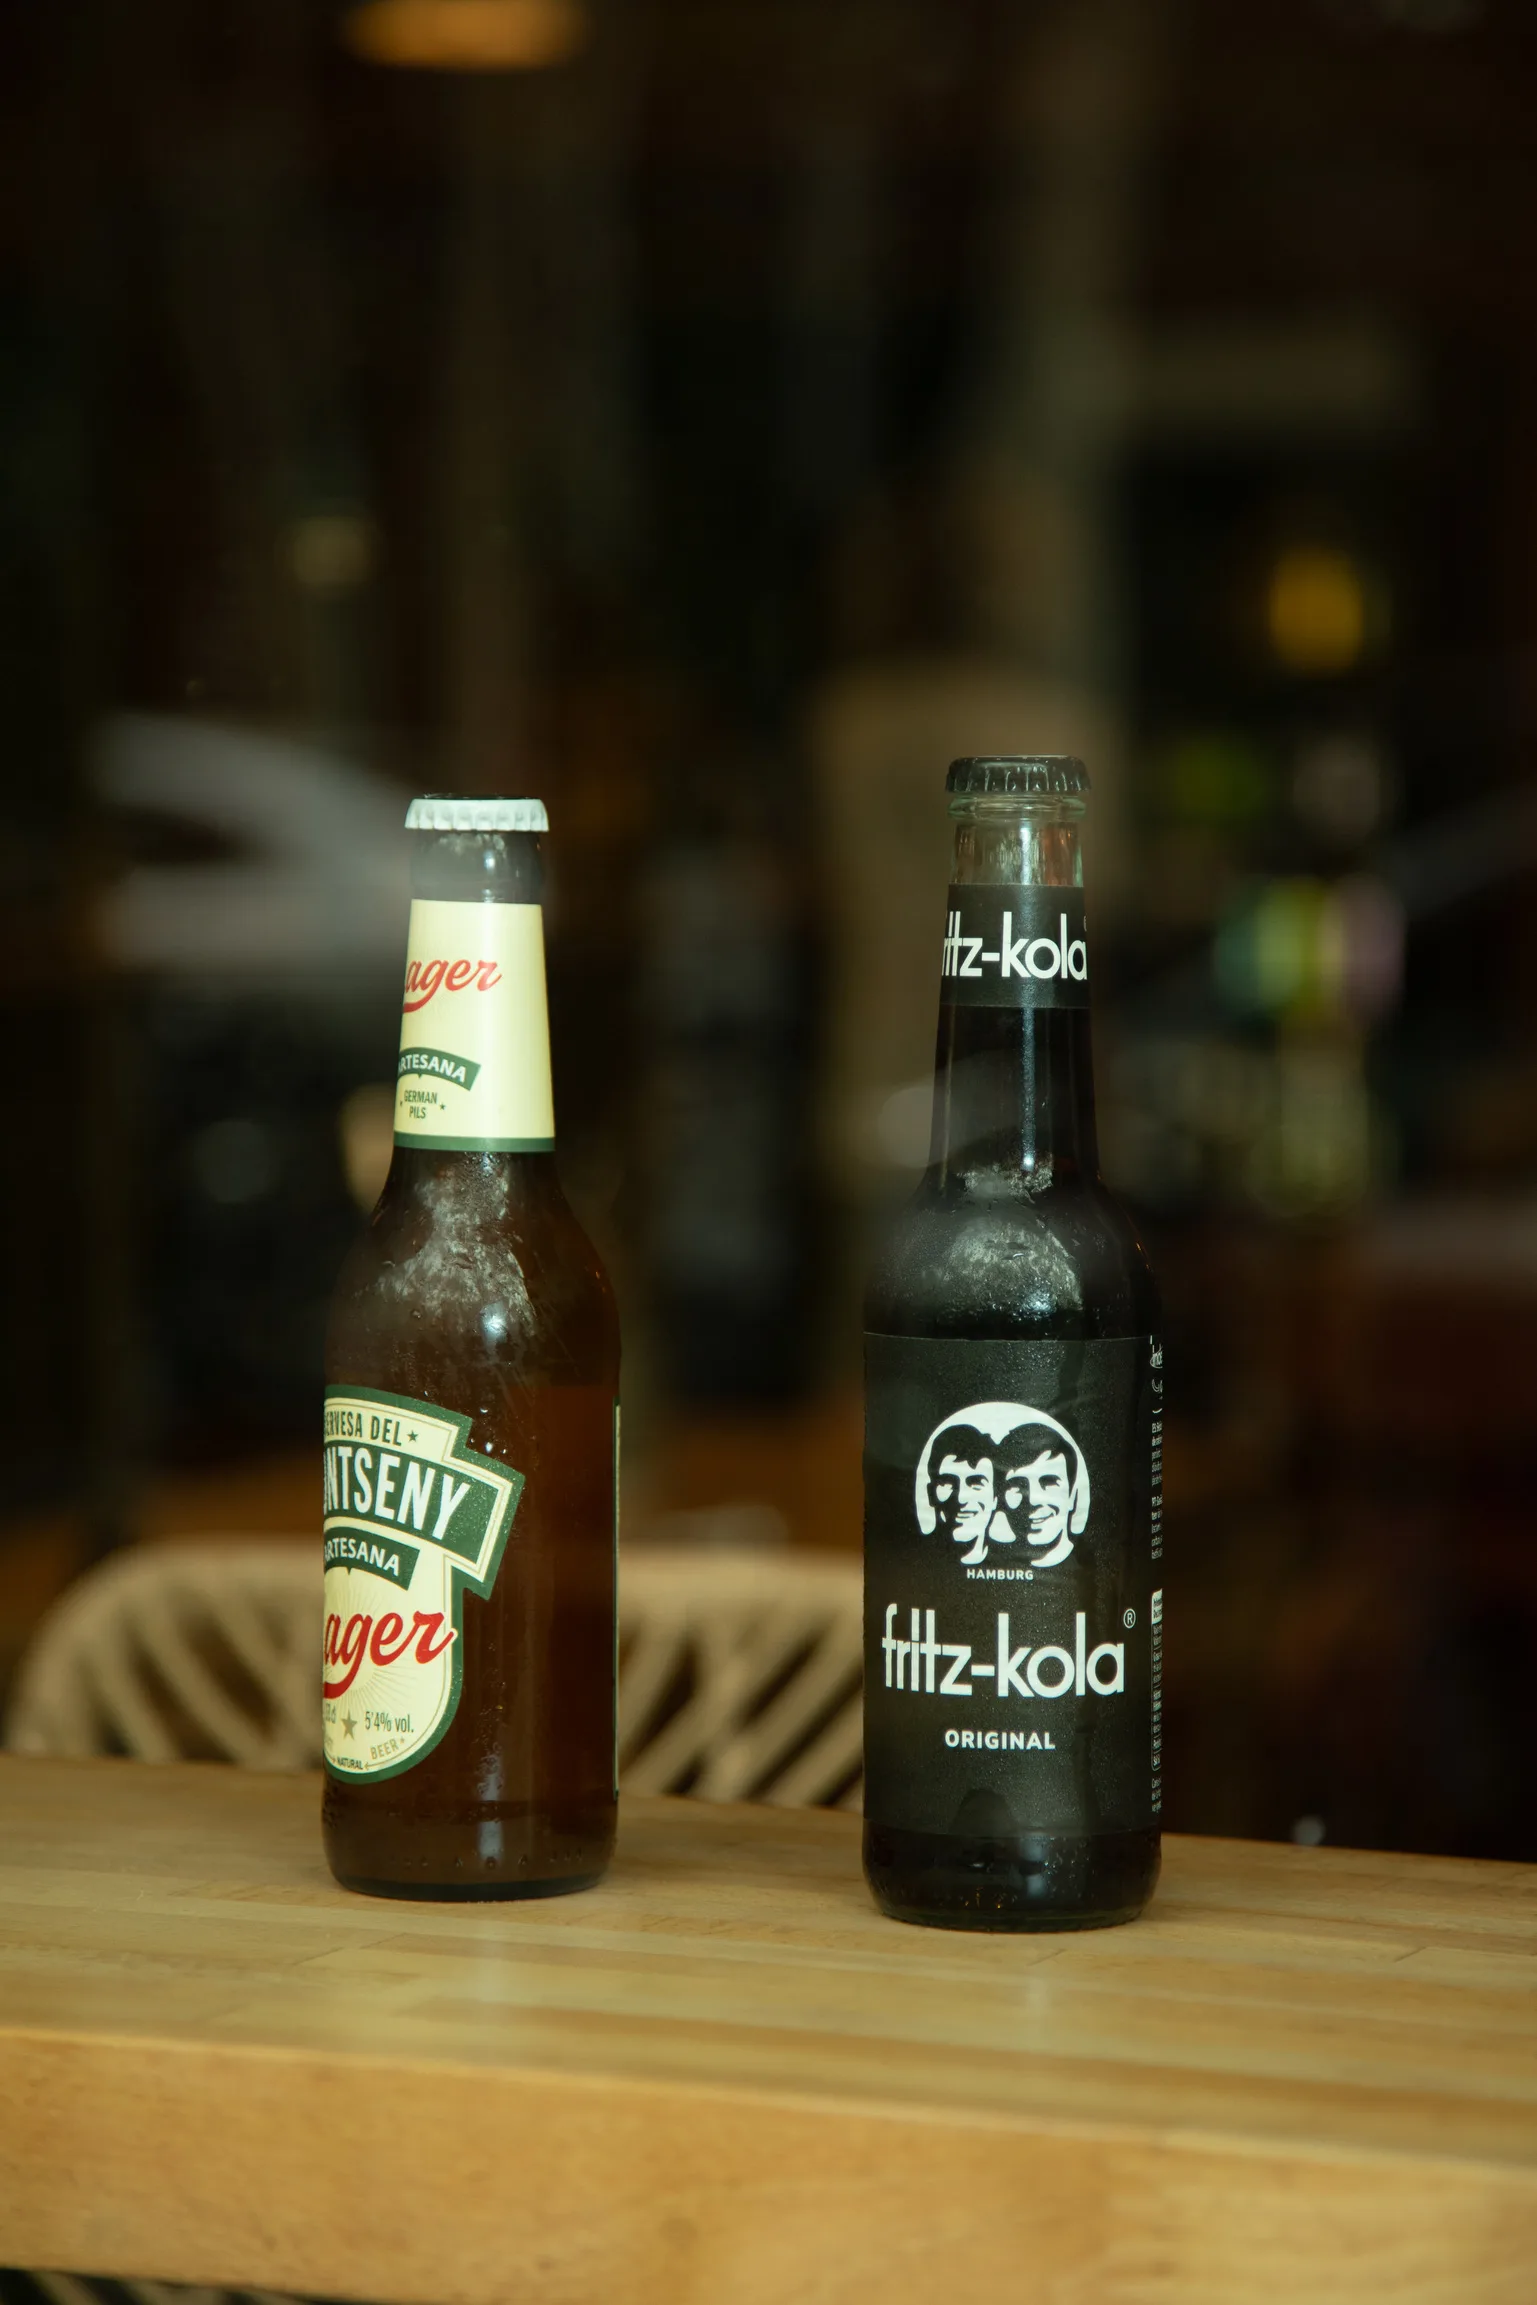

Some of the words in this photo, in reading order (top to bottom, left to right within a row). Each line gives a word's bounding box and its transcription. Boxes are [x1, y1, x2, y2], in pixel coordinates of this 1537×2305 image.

[941, 910, 1088, 981] ritz-kola
[403, 958, 503, 1014] ager
[403, 1089, 438, 1104] GERMAN
[408, 1105, 427, 1119] PILS
[325, 1410, 363, 1438] ERVESA
[369, 1415, 402, 1447] DEL
[323, 1445, 471, 1541] NTSENY
[966, 1568, 1035, 1581] HAMBURG
[323, 1610, 455, 1700] ager
[881, 1602, 1125, 1699] fritz-kola
[394, 1713, 415, 1734] vol.
[369, 1738, 399, 1760] BEER
[944, 1728, 1056, 1751] ORIGINAL
[336, 1756, 364, 1771] NATURAL
